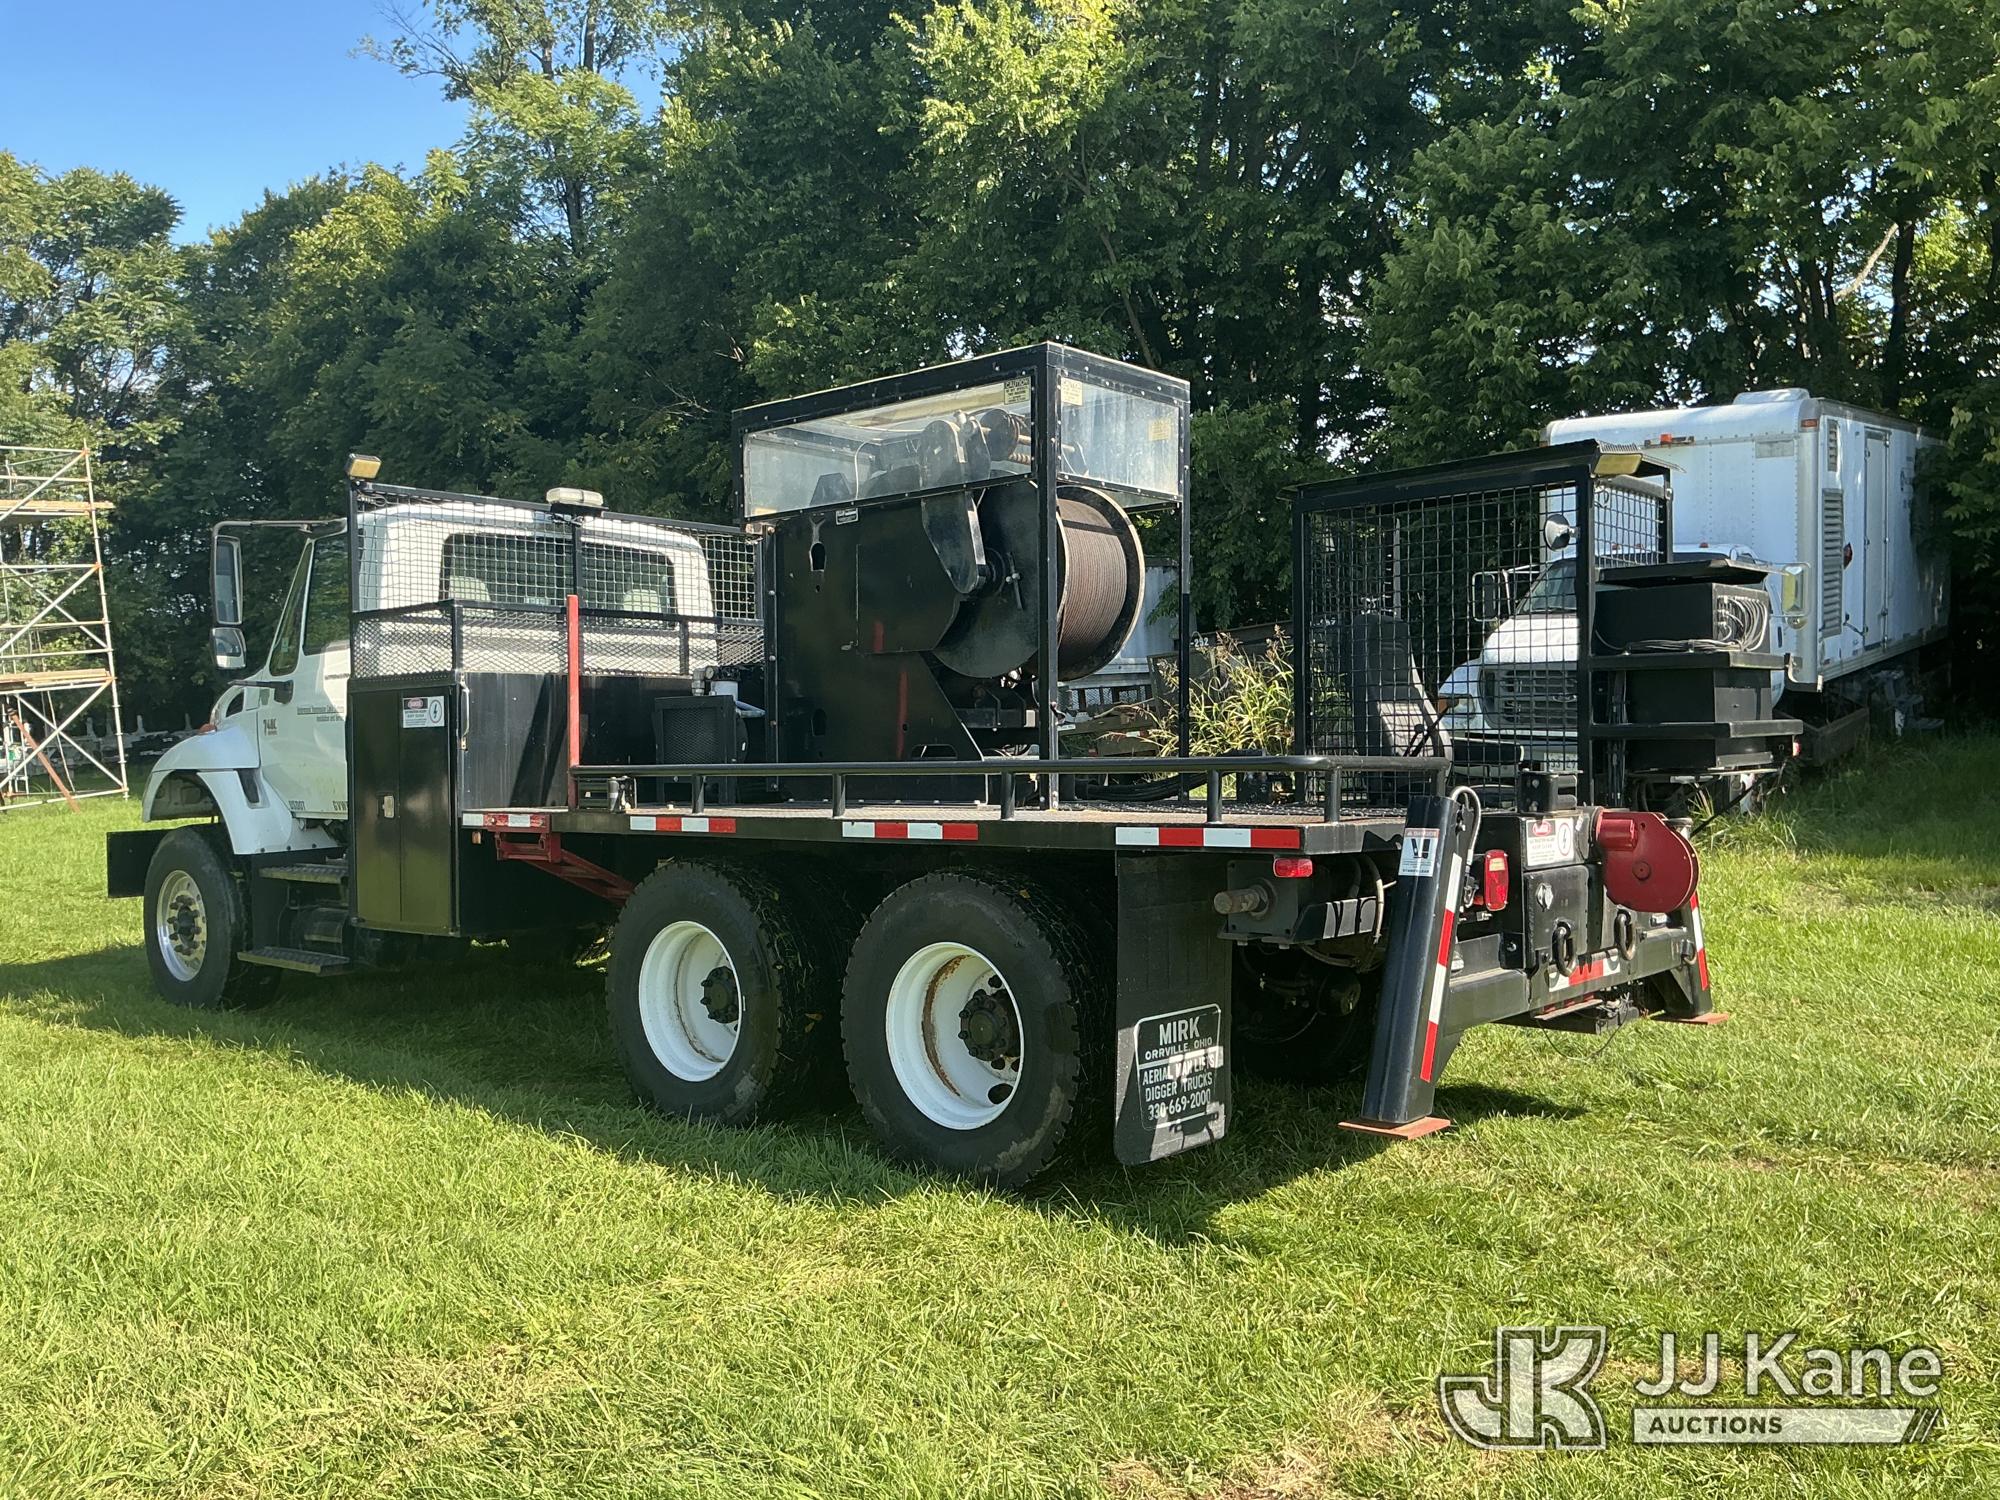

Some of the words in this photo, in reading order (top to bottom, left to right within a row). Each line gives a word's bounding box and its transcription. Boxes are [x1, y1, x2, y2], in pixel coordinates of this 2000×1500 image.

[1159, 1016, 1201, 1046] MIRK
[1193, 1036, 1213, 1049] OHIO
[1142, 1065, 1174, 1086] AERIAL
[1145, 1080, 1178, 1102] DIGGER
[1182, 1071, 1213, 1093] TRUCKS
[1148, 1088, 1211, 1121] 330-669-2000
